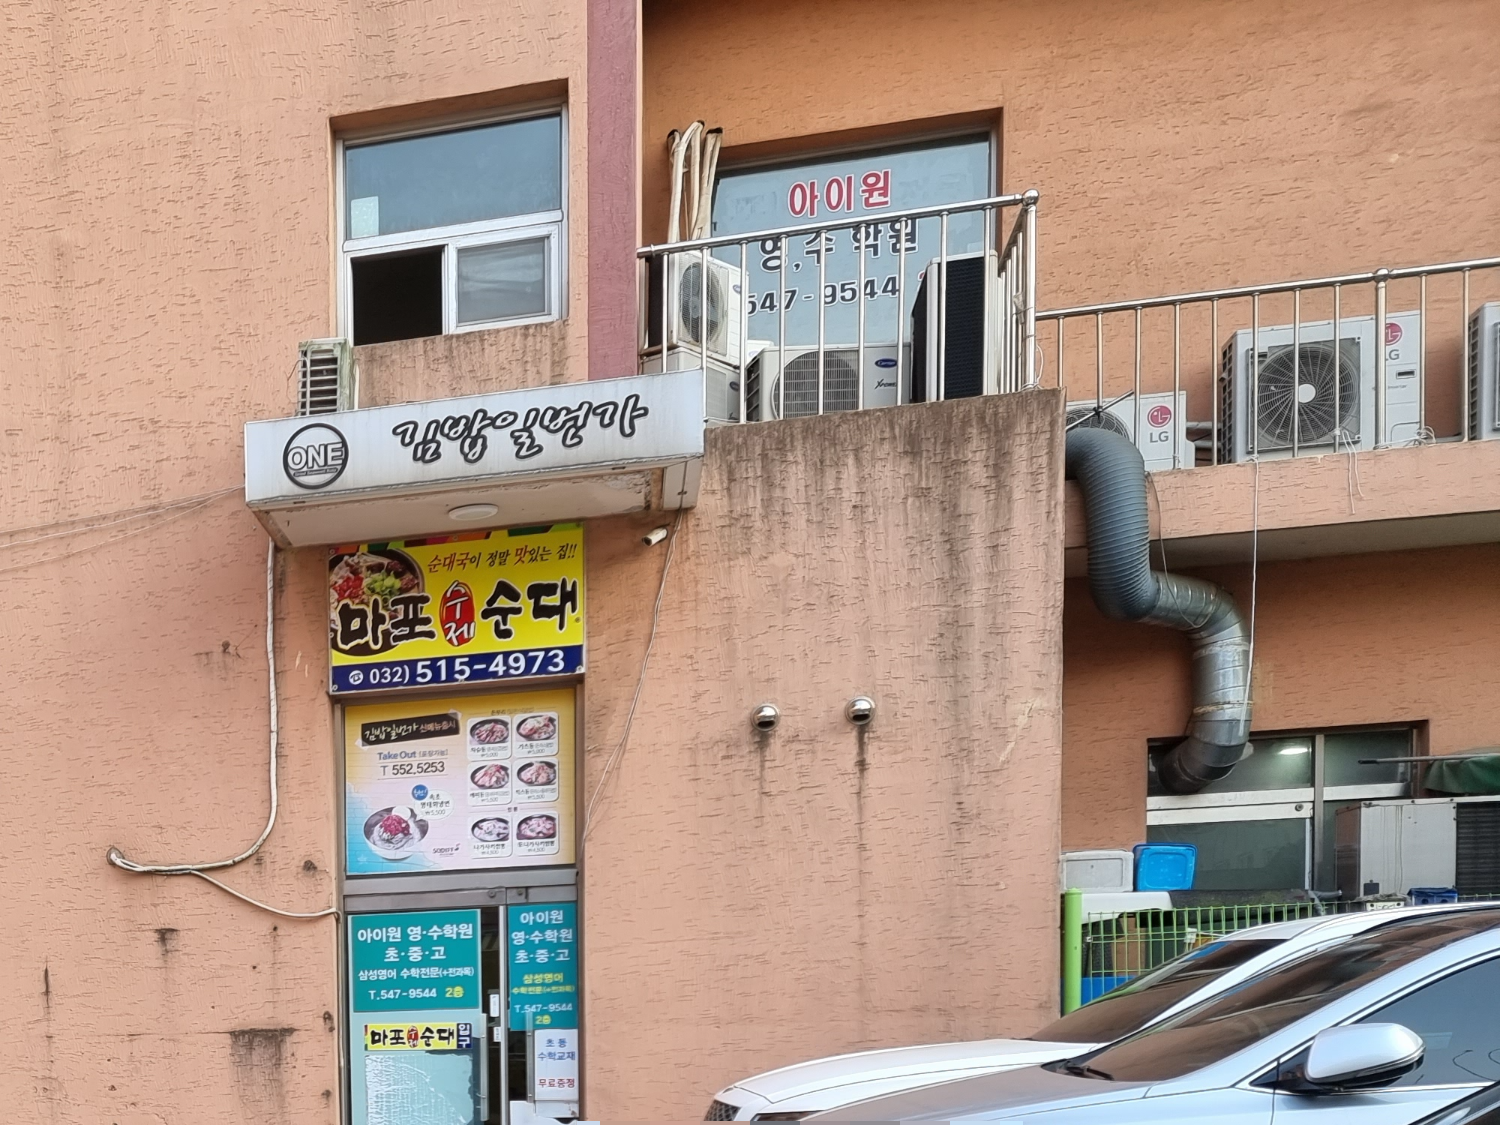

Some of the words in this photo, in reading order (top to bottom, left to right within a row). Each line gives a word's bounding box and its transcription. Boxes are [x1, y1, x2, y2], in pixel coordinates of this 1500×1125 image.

[788, 169, 891, 217] 아이원
[392, 394, 649, 463] 김밥일번가
[1149, 431, 1169, 443] LG
[287, 442, 344, 471] ONE
[427, 552, 482, 574] 순대국이
[485, 550, 511, 567] 정말
[514, 545, 552, 566] 맛있는
[556, 542, 577, 560] 집!!
[336, 594, 436, 649] 마포
[481, 576, 578, 640] 순대
[415, 650, 565, 683] 515-4973
[377, 751, 398, 760] Take
[399, 750, 417, 759] Out
[392, 761, 445, 776] 552.5253
[520, 910, 564, 925] 아이원
[357, 927, 402, 943] 아이원
[358, 968, 397, 981] 삼성영어
[370, 1029, 406, 1046] 마포
[420, 1026, 454, 1048] 순대
